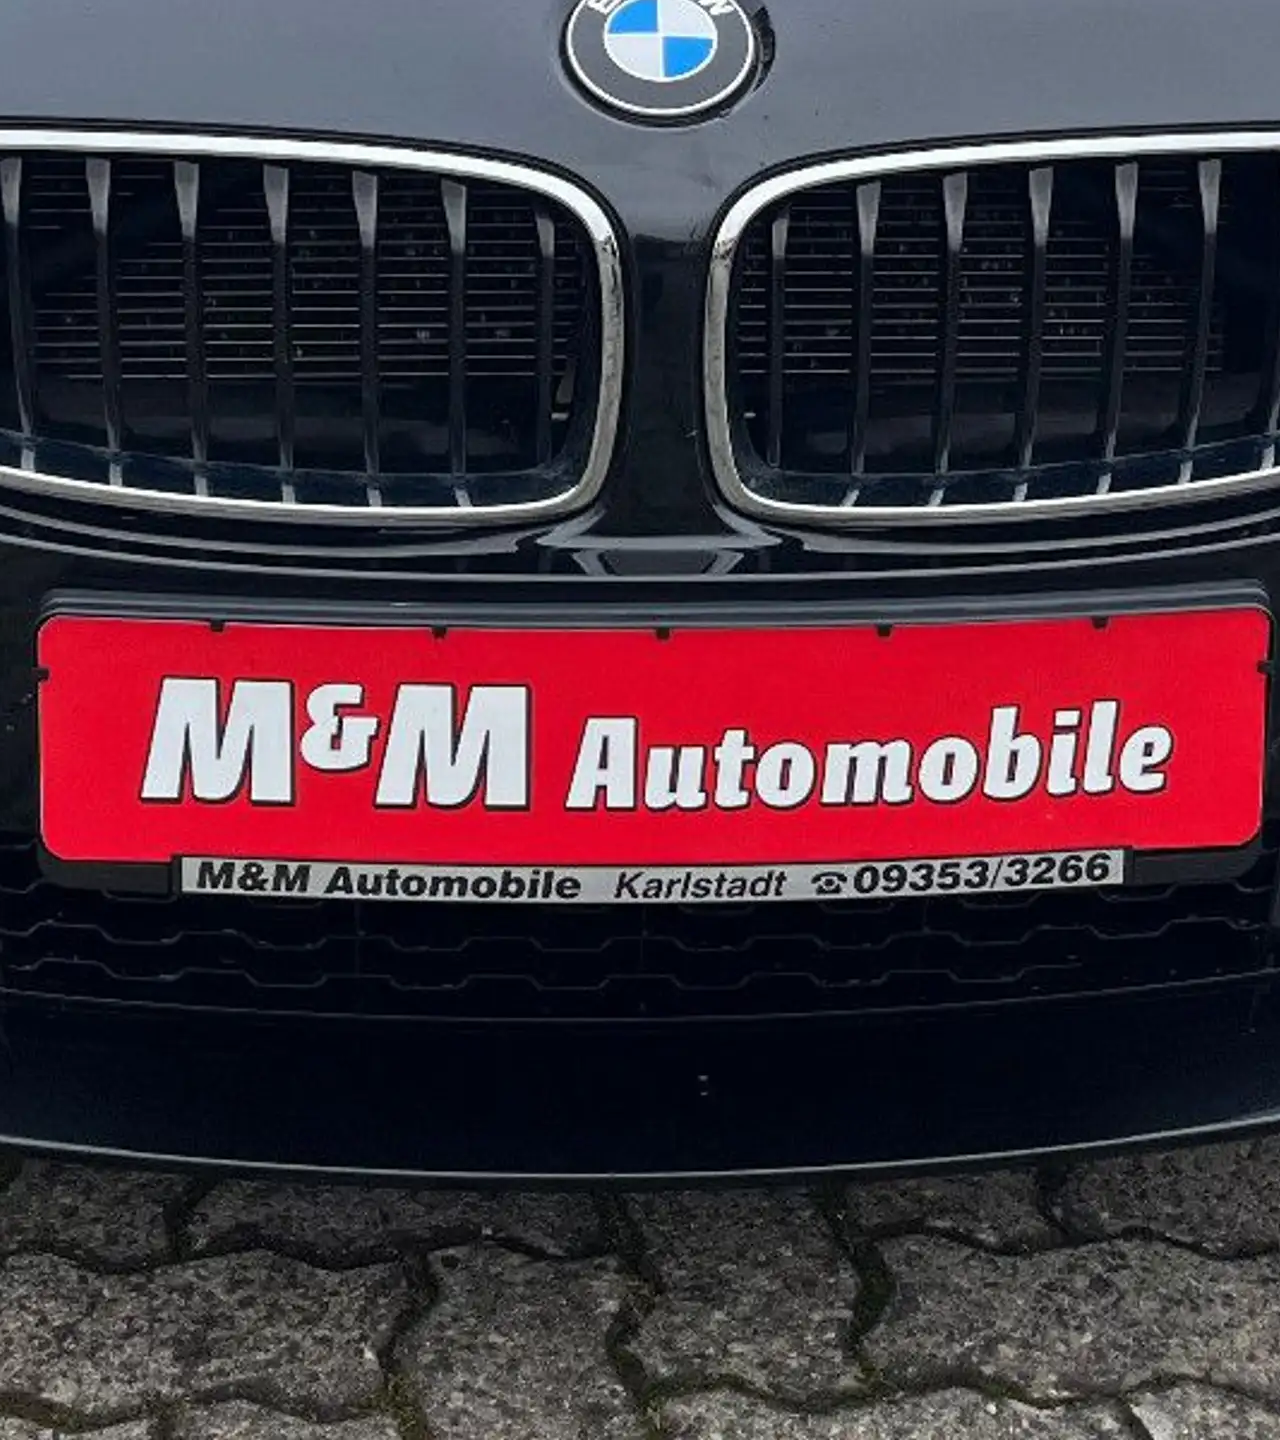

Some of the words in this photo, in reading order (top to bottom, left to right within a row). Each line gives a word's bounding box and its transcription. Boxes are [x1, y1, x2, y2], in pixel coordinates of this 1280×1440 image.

[139, 674, 532, 810] M&M
[564, 699, 1176, 811] Automobile
[196, 861, 312, 893] M&M
[323, 866, 582, 900] Automobile
[613, 869, 787, 900] Karlstadt
[852, 852, 1111, 894] 09353/3266
